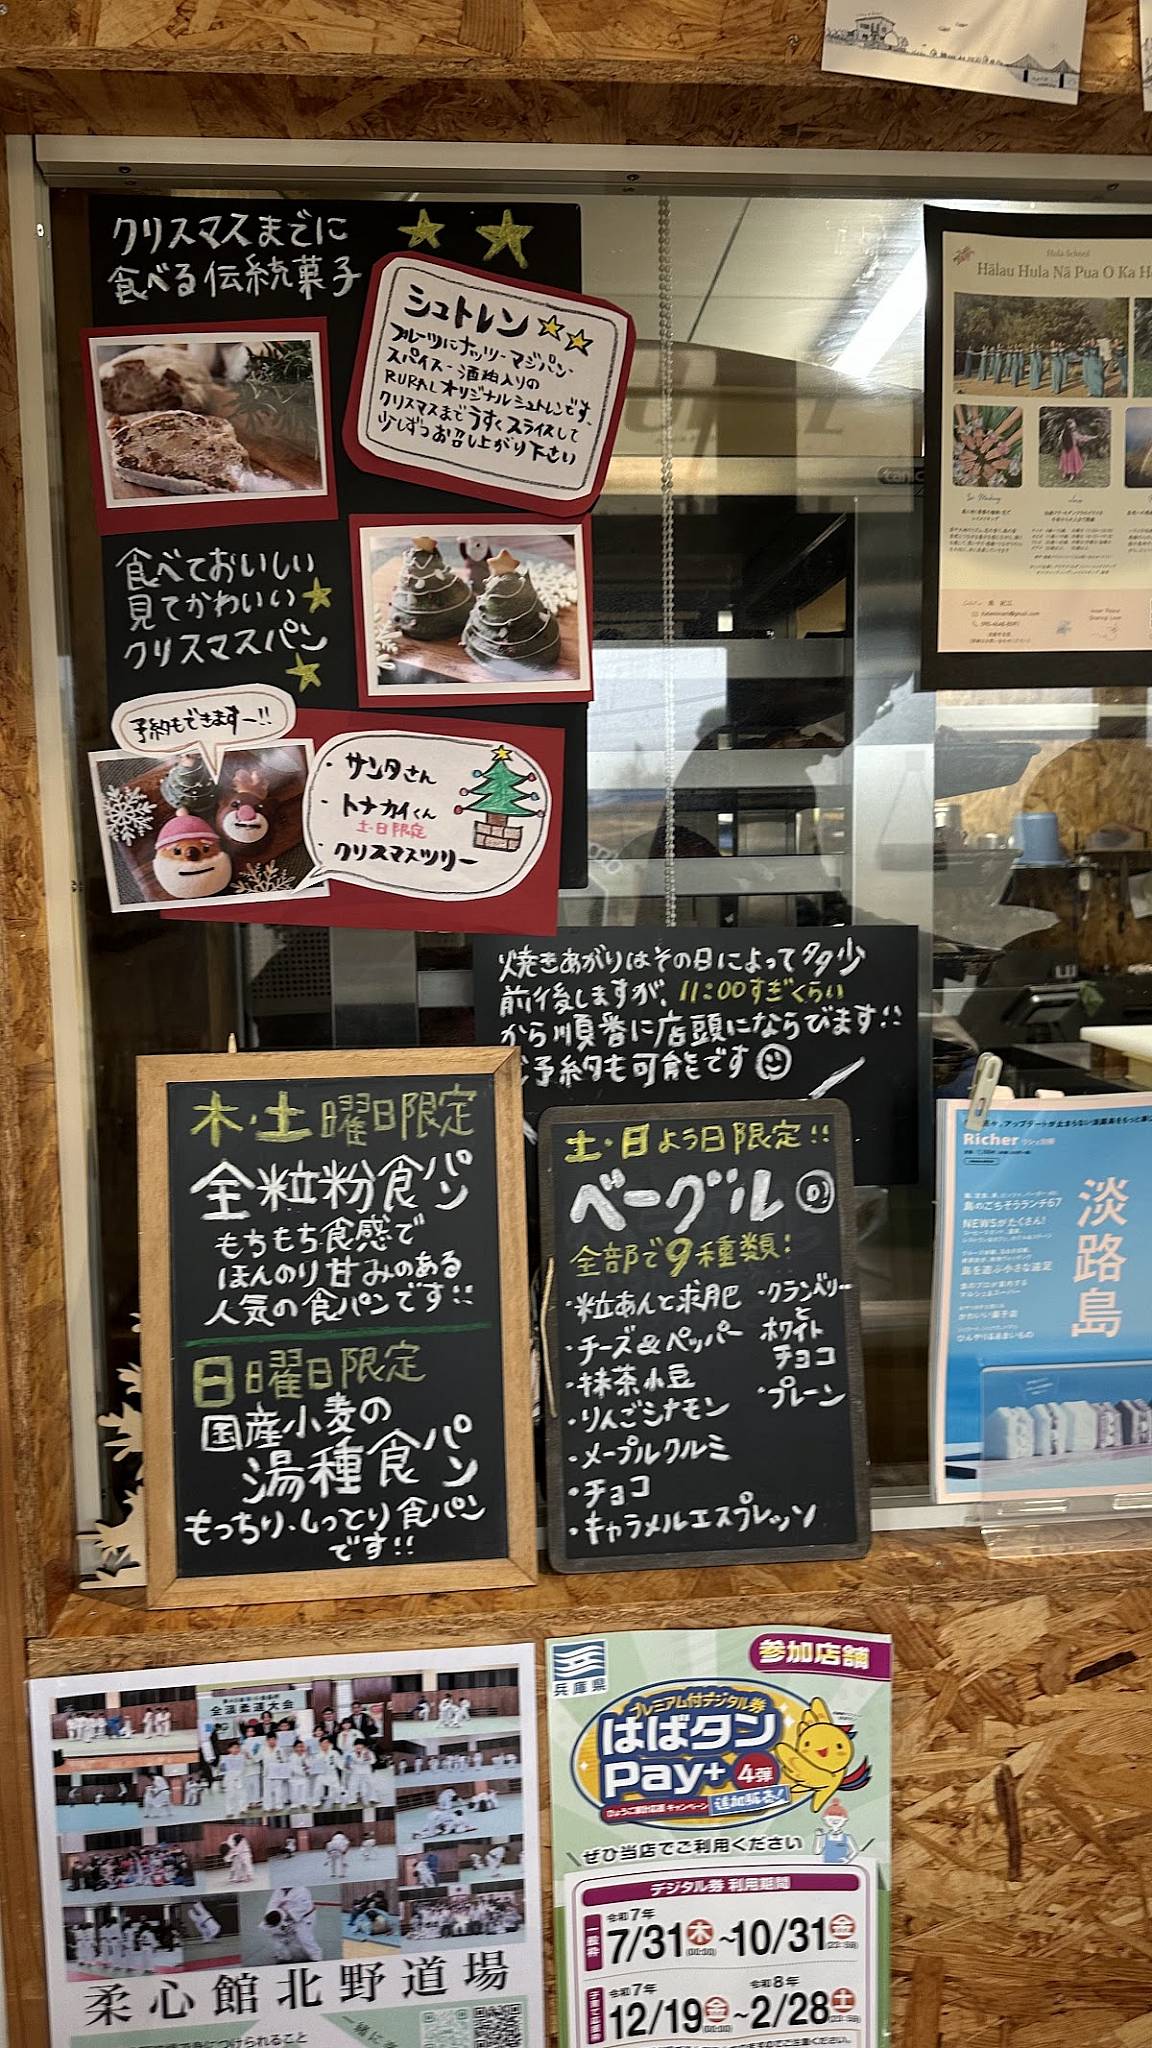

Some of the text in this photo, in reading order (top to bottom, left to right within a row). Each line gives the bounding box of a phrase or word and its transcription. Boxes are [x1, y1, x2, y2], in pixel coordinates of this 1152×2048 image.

[113, 208, 349, 256] クリスマスまでに
[107, 253, 362, 304] 食べる伝統菓子
[1018, 264, 1049, 279] Hula
[1074, 266, 1099, 279] Pua
[1102, 265, 1114, 279] O
[1118, 266, 1136, 279] Ka
[1139, 266, 1152, 279] H
[403, 283, 529, 337] シュトレン
[377, 411, 576, 465] 少しずつお召し上がり下さい
[115, 547, 315, 591] 食べておいしい
[128, 588, 296, 631] 見てかわいい
[124, 618, 329, 670] クリスマスパン
[345, 751, 437, 785] サンタさん
[343, 792, 437, 820] トナカイくん
[334, 841, 479, 872] クリスマスツリー
[963, 1132, 1020, 1146] Richer
[190, 1149, 474, 1220] 全粒粉食パン
[569, 1168, 785, 1236] ベーグル
[214, 1212, 426, 1258] もちもち食感で
[218, 1250, 463, 1291] ほんのり甘みのある
[1071, 1176, 1130, 1339] 淡路島
[574, 1279, 743, 1324] 粒あんと求肥
[767, 1271, 853, 1304] クランベリー
[759, 1316, 824, 1342] ホワイト
[772, 1344, 836, 1370] チョコ
[576, 1363, 696, 1399] 抹茶小豆
[767, 1375, 846, 1410] プレーン
[200, 1391, 392, 1451] 国産小麦の
[582, 1397, 731, 1433] りんごシナモン
[241, 1413, 479, 1504] 湯種食パン
[581, 1434, 732, 1470] メープルクルミ
[583, 1475, 650, 1509] チョコ
[758, 1639, 870, 1670] 参加店舗
[554, 1677, 607, 1697] 兵庫県
[629, 1691, 767, 1719] プレミアム付デジタル券
[602, 1713, 777, 1756] はばタン
[737, 1763, 774, 1785] 4弾
[583, 1836, 803, 1865] ぜひ当店でご利用ください
[650, 1876, 791, 1897] デジタル券 利用期間
[607, 1922, 683, 1964] 7/31
[84, 1950, 510, 2027] 柔心館北野道場
[609, 1998, 702, 2040] 12/19
